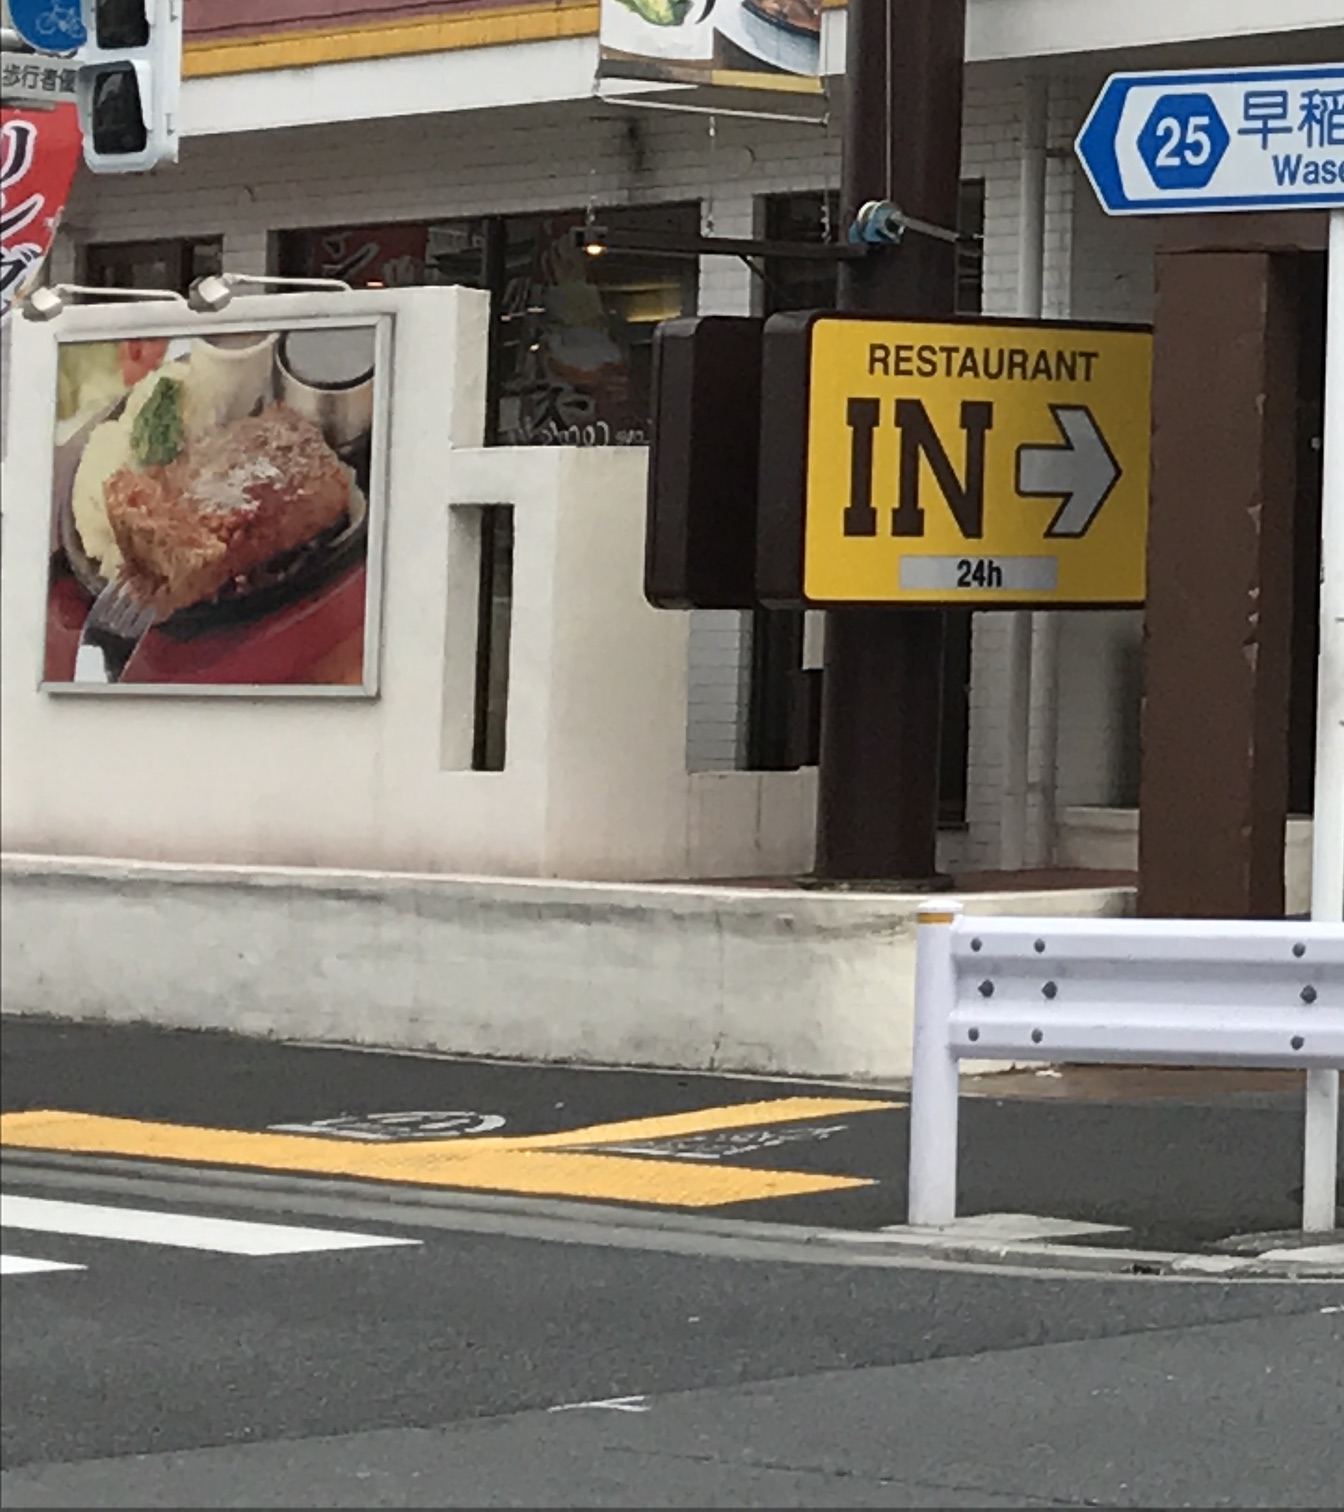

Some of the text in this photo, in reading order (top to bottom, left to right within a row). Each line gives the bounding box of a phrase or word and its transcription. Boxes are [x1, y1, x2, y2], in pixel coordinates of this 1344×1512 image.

[2, 62, 77, 93] 歩行者優
[1155, 116, 1212, 168] 25
[868, 343, 1099, 382] RESTAURANT
[843, 397, 994, 539] IN
[956, 558, 1002, 588] 24h
